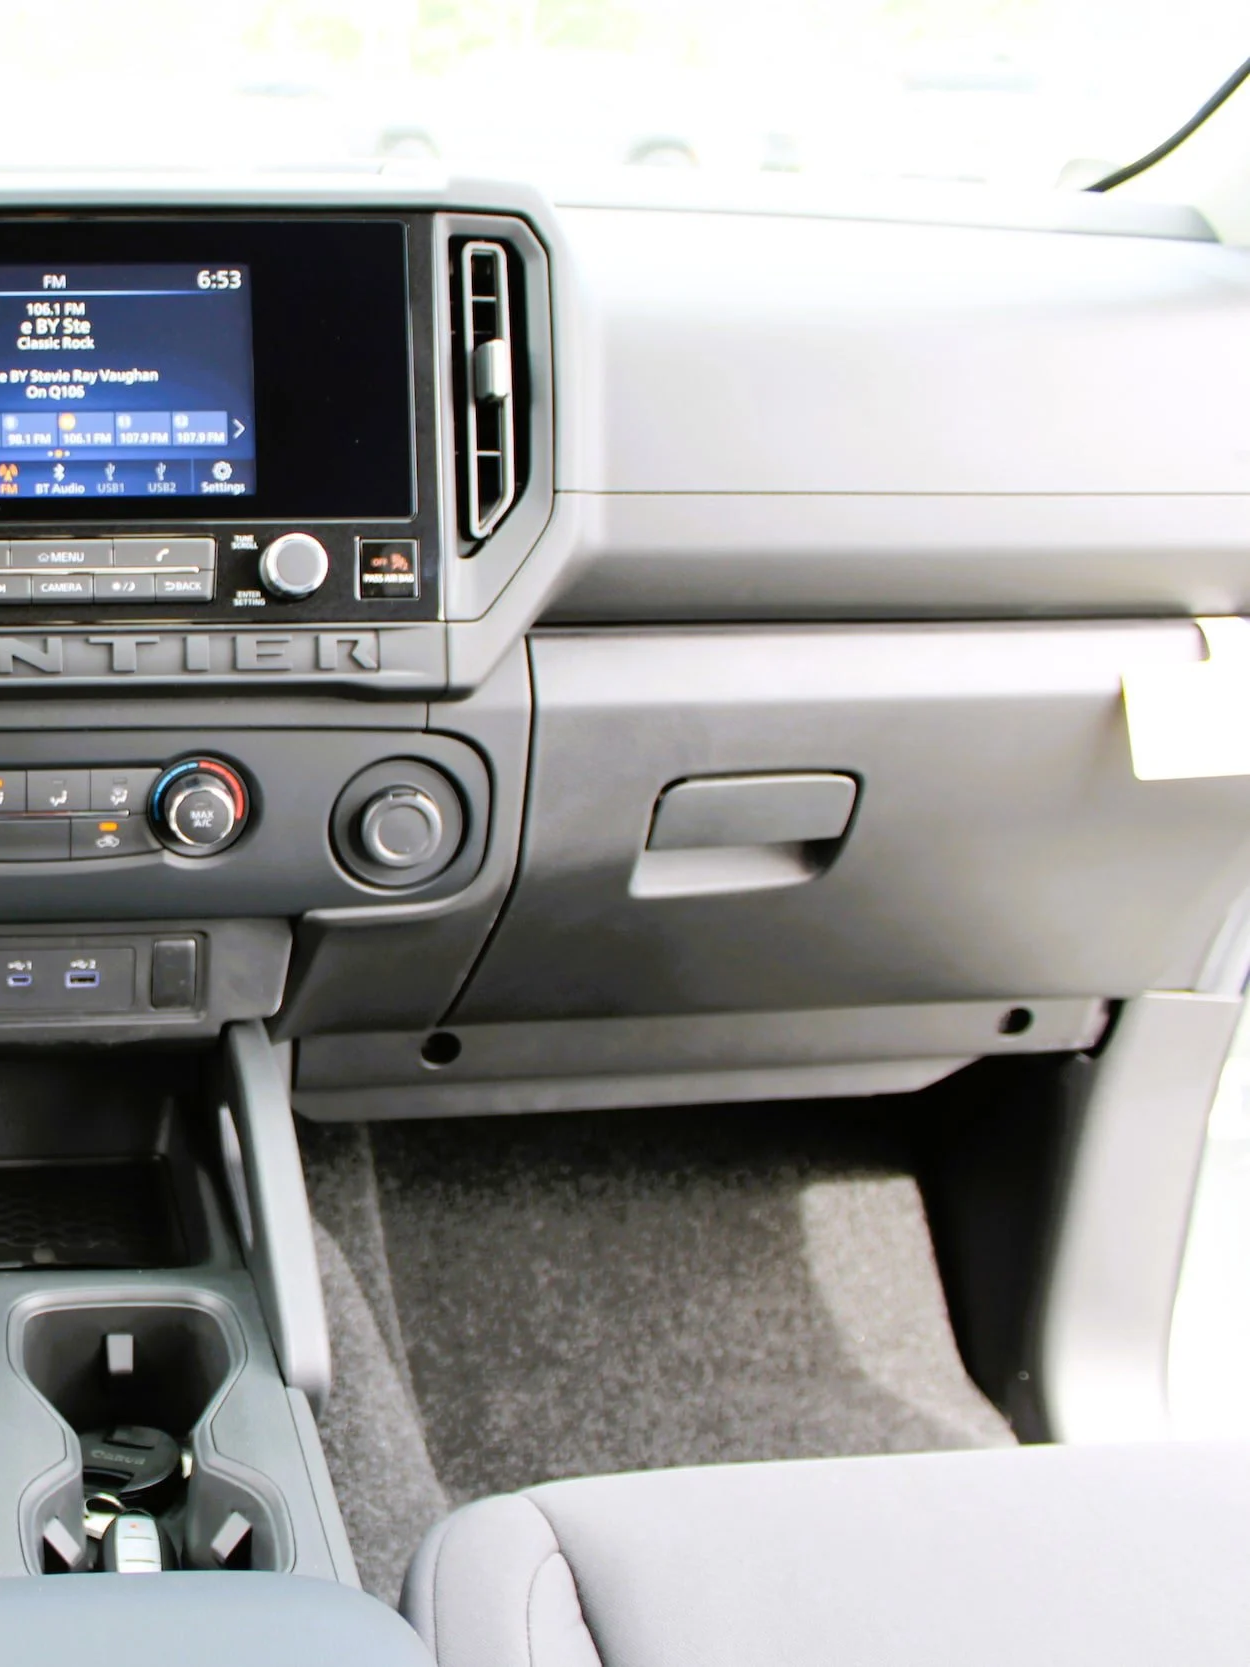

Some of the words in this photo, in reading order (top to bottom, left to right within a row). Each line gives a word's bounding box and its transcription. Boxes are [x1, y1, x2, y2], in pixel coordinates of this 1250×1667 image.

[43, 275, 67, 289] FM
[197, 270, 242, 289] 6:53
[26, 302, 61, 316] 106.1
[64, 302, 86, 316] FM
[20, 320, 33, 335] e
[36, 318, 60, 335] BY
[62, 318, 91, 335] Ste
[17, 336, 60, 350] Classic
[62, 336, 95, 350] Rock
[9, 369, 29, 383] BY
[30, 369, 70, 383] Stevie
[72, 369, 98, 385] Ray
[99, 368, 159, 385] Vaughan
[25, 386, 48, 399] On
[33, 433, 52, 445] FM
[93, 432, 112, 445] FM
[150, 432, 169, 443] FM
[206, 431, 225, 443] FM
[0, 483, 19, 495] FM
[35, 483, 50, 496] BT
[51, 483, 86, 495] Audio
[97, 482, 125, 493] USB1
[147, 482, 177, 493] USB2
[201, 481, 246, 496] Settings
[50, 552, 85, 563] MENU
[40, 584, 83, 593] CAMERA
[177, 581, 202, 591] BACK
[190, 810, 215, 820] MAX
[193, 819, 213, 828] A/C
